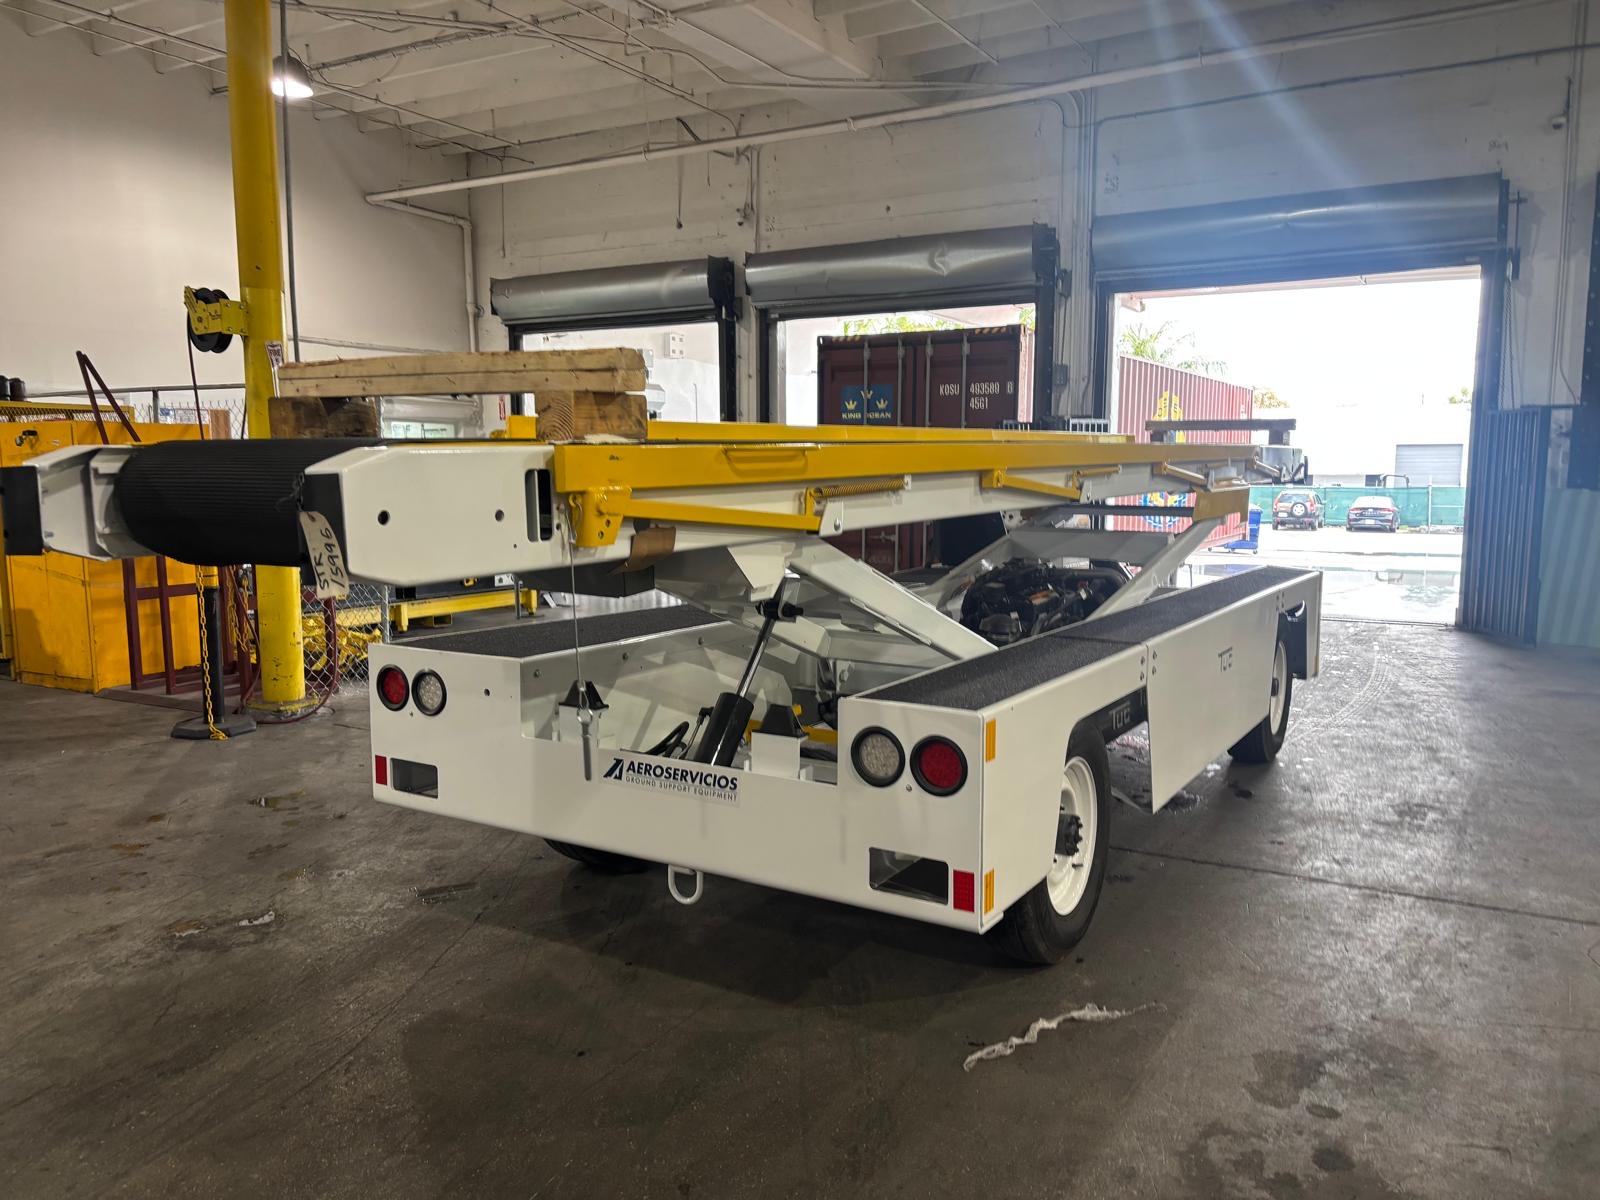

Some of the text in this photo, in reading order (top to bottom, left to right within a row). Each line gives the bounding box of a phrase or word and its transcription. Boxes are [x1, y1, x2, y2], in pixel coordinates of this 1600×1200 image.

[625, 776, 737, 802] GROUND SUPPORT EQUIPMENT
[626, 760, 738, 791] AEROSERVICIOS
